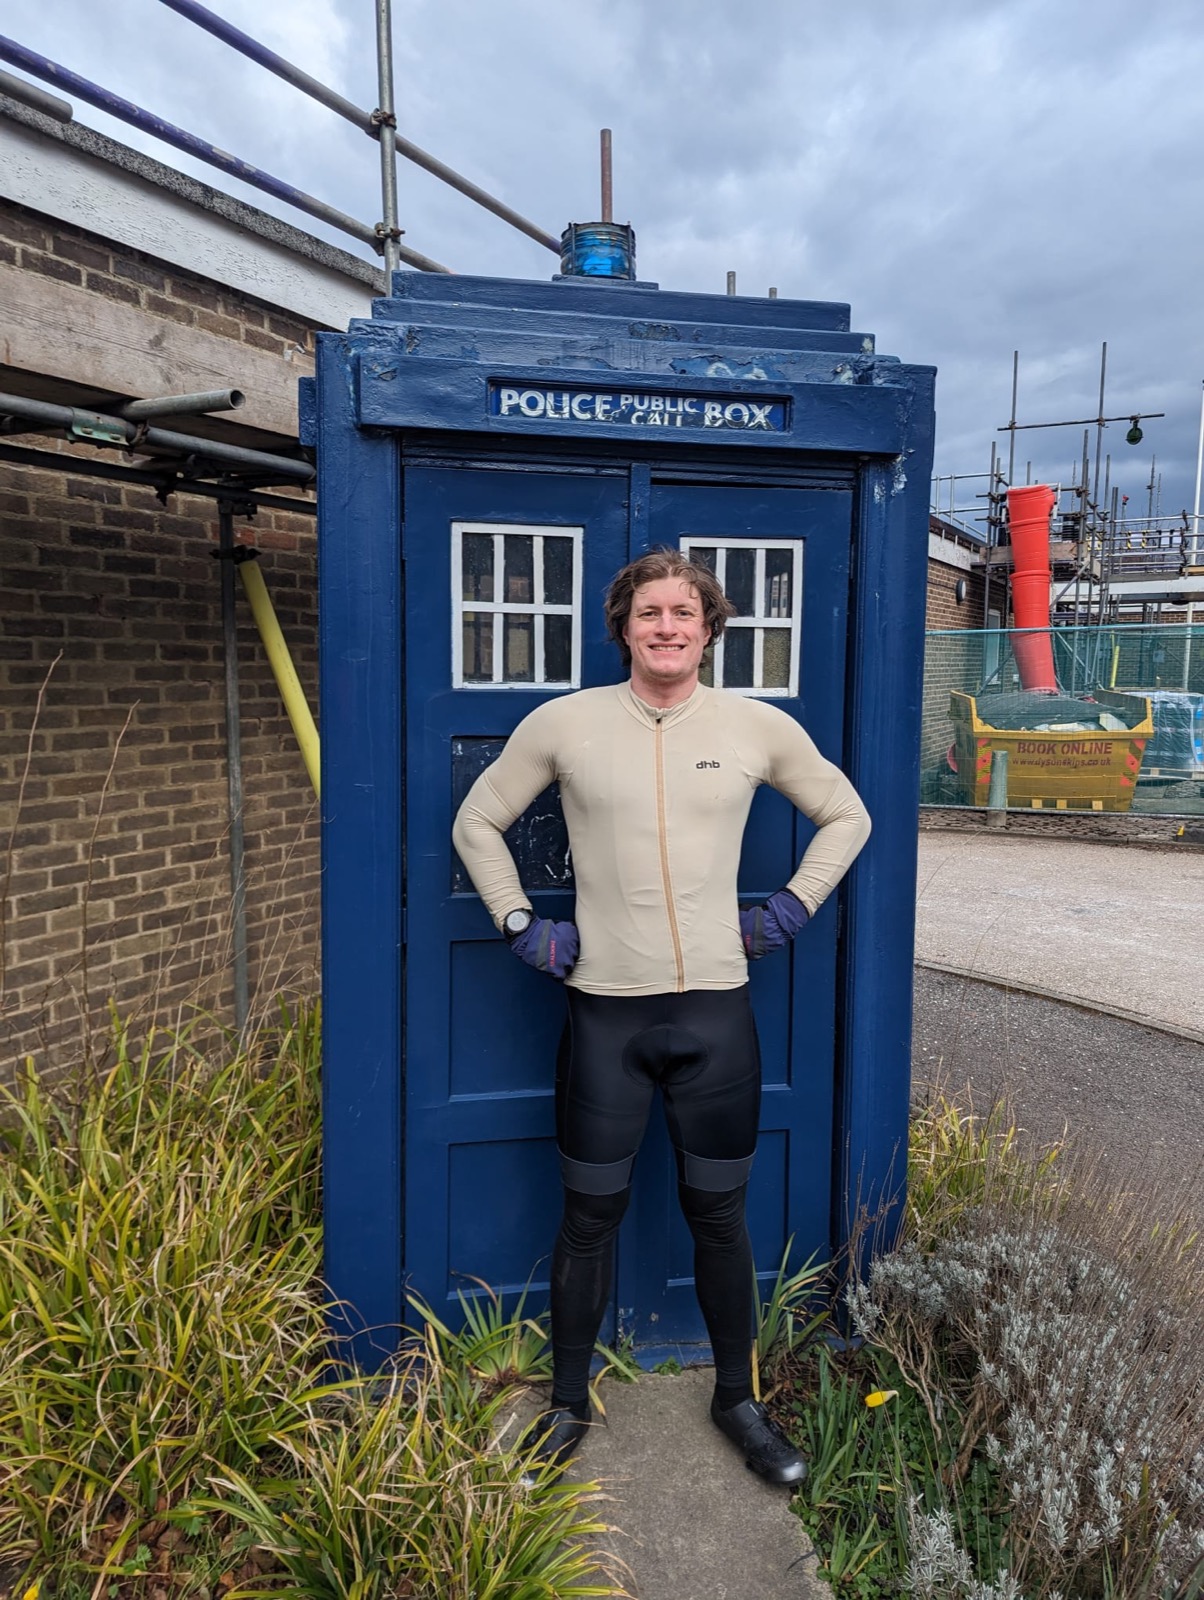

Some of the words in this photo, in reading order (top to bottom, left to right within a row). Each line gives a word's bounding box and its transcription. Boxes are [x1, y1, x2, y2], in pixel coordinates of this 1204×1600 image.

[500, 389, 613, 421] POLICE
[620, 394, 698, 413] PUBLIC
[703, 401, 776, 431] BOX
[1017, 742, 1057, 755] BOOK
[1061, 742, 1113, 755] ONLINE
[695, 760, 721, 770] dhb
